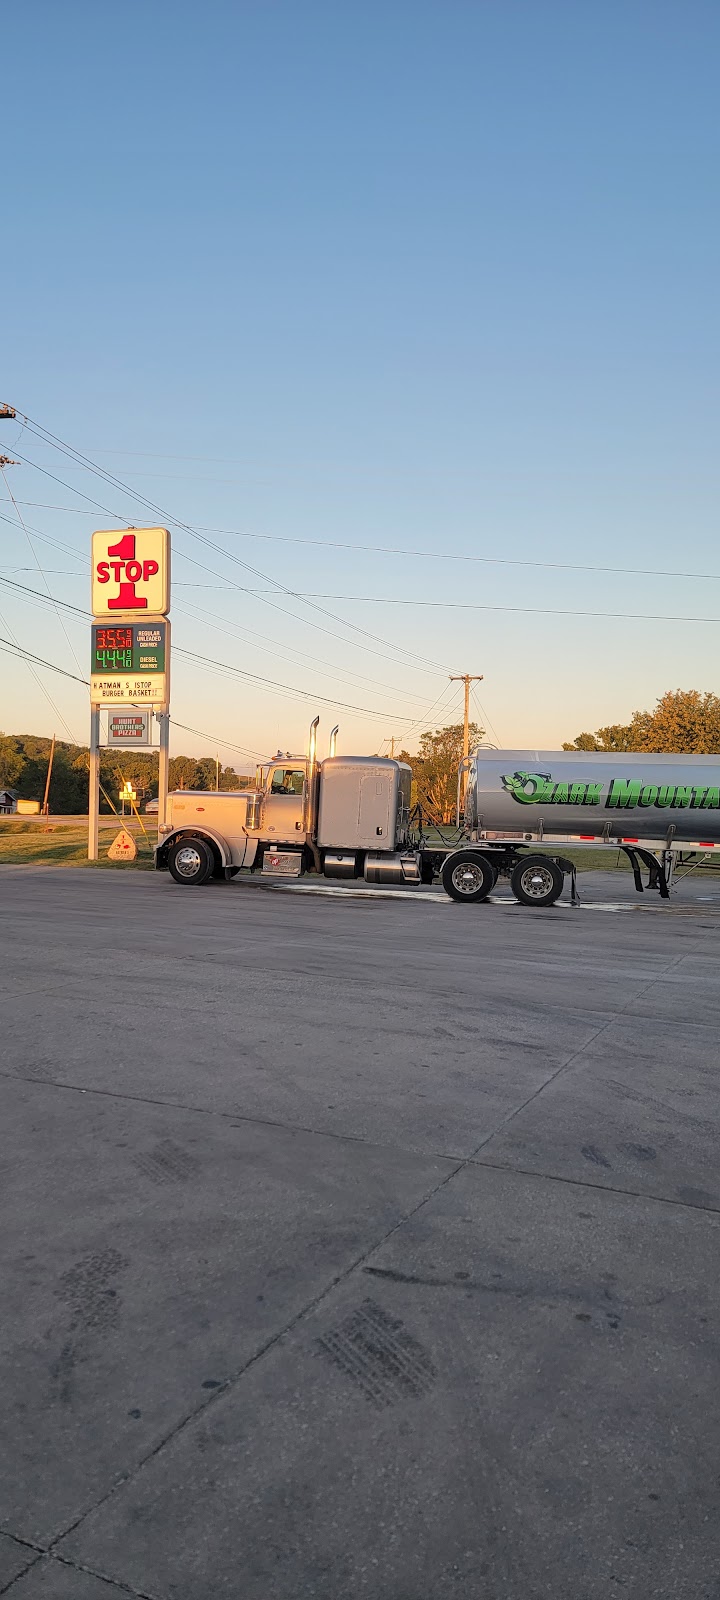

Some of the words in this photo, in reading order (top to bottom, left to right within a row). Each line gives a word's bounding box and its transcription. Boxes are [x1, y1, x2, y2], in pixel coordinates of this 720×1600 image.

[96, 560, 159, 583] STOP
[108, 534, 148, 610] 1
[510, 773, 604, 805] OZARK
